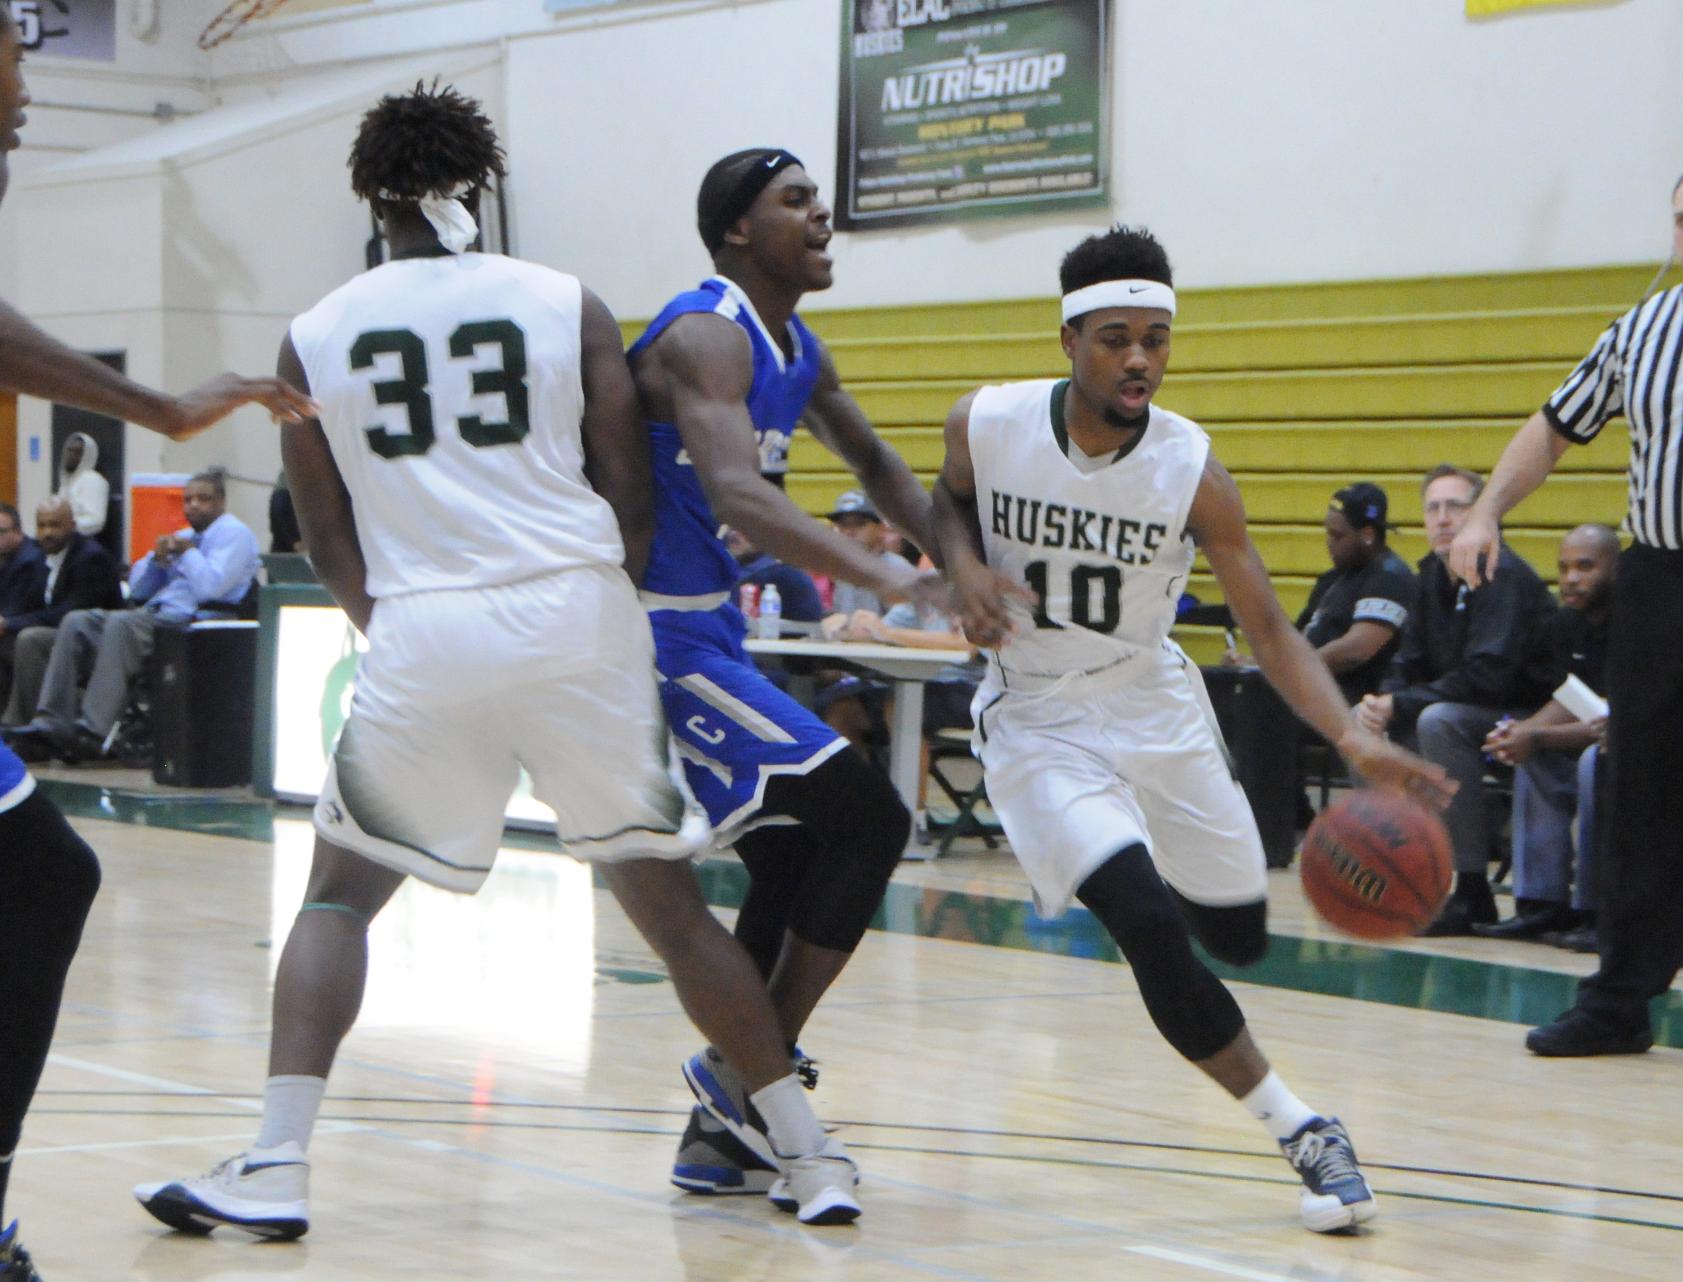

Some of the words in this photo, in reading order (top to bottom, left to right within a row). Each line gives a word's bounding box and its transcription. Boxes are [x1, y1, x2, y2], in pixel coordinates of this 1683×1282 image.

[880, 53, 1067, 111] NUTRISHOP
[349, 318, 531, 460] 33
[991, 487, 1167, 565] HUSKIES
[1024, 560, 1124, 634] 10
[686, 715, 726, 745] C
